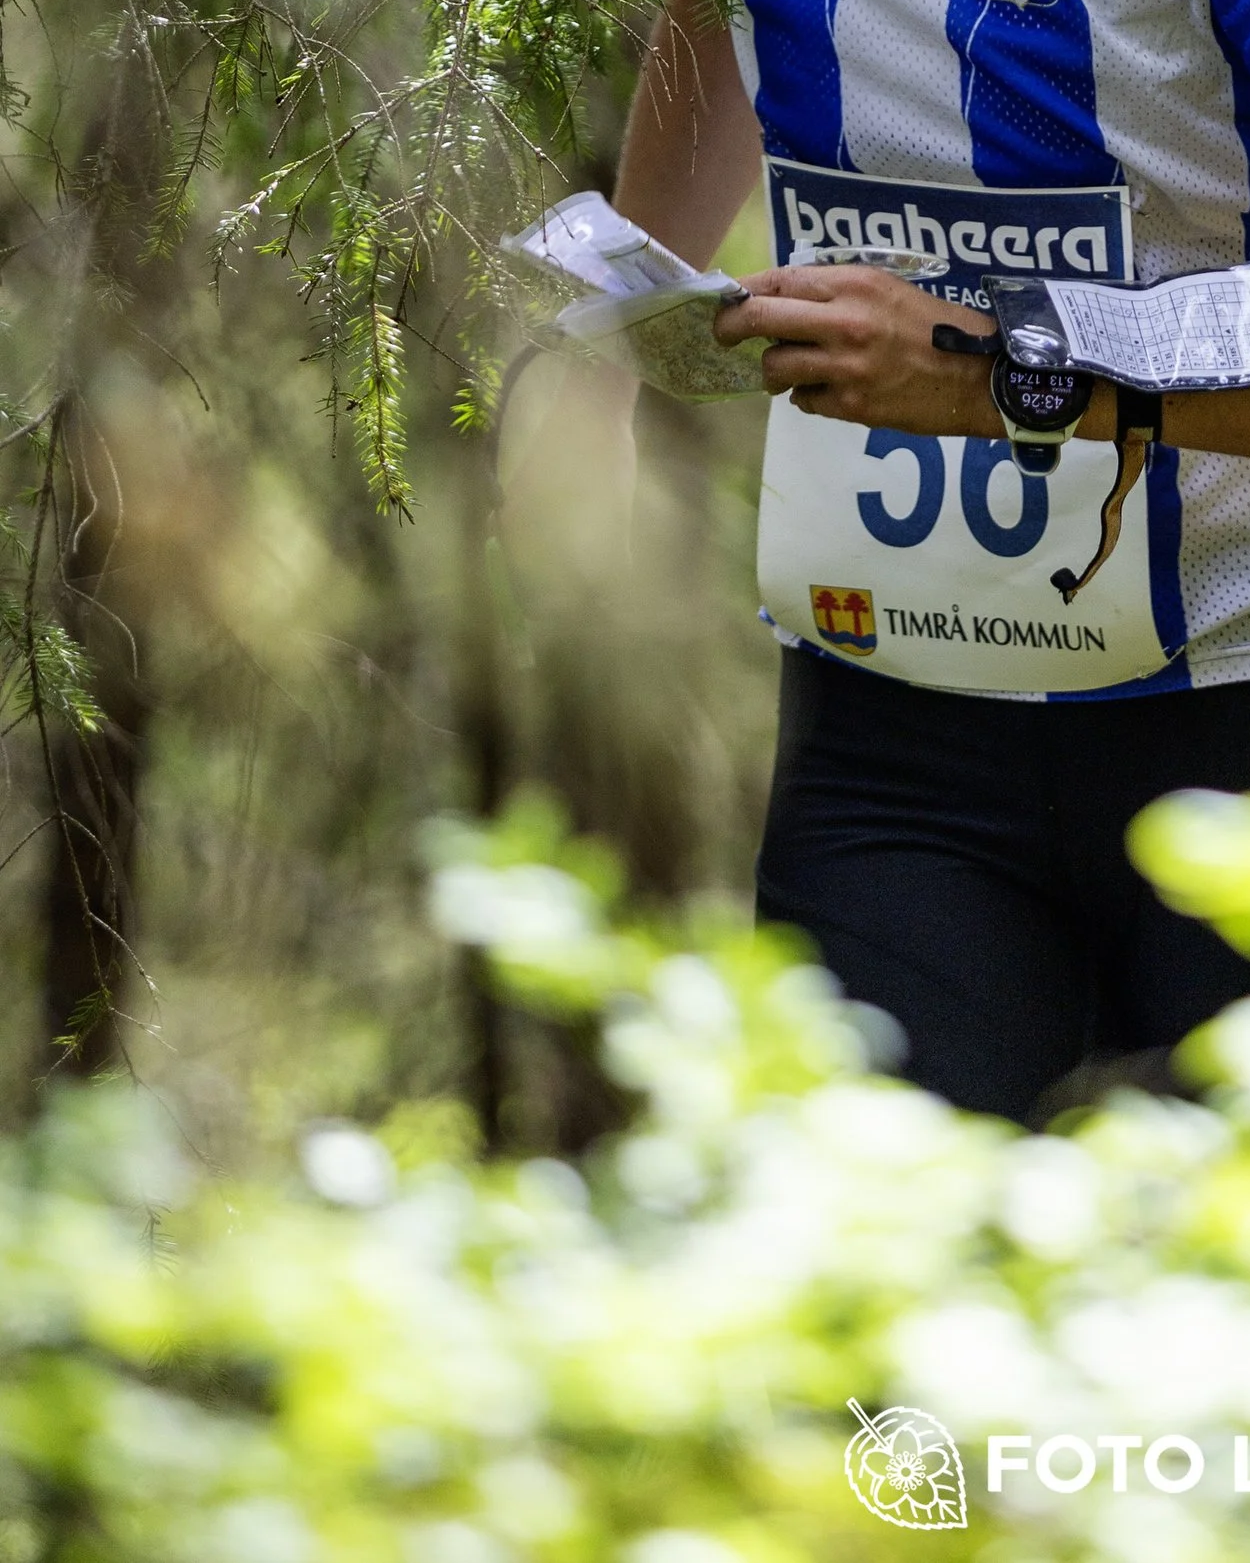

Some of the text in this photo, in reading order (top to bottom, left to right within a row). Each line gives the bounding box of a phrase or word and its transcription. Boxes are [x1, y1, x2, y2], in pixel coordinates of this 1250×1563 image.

[783, 187, 1108, 273] bagheera
[1010, 372, 1040, 385] 17:45
[1049, 375, 1074, 387] 5.13
[1022, 392, 1064, 410] 43:26
[857, 425, 1050, 558] 56
[883, 604, 1106, 652] TIMRÅ KOMMUN
